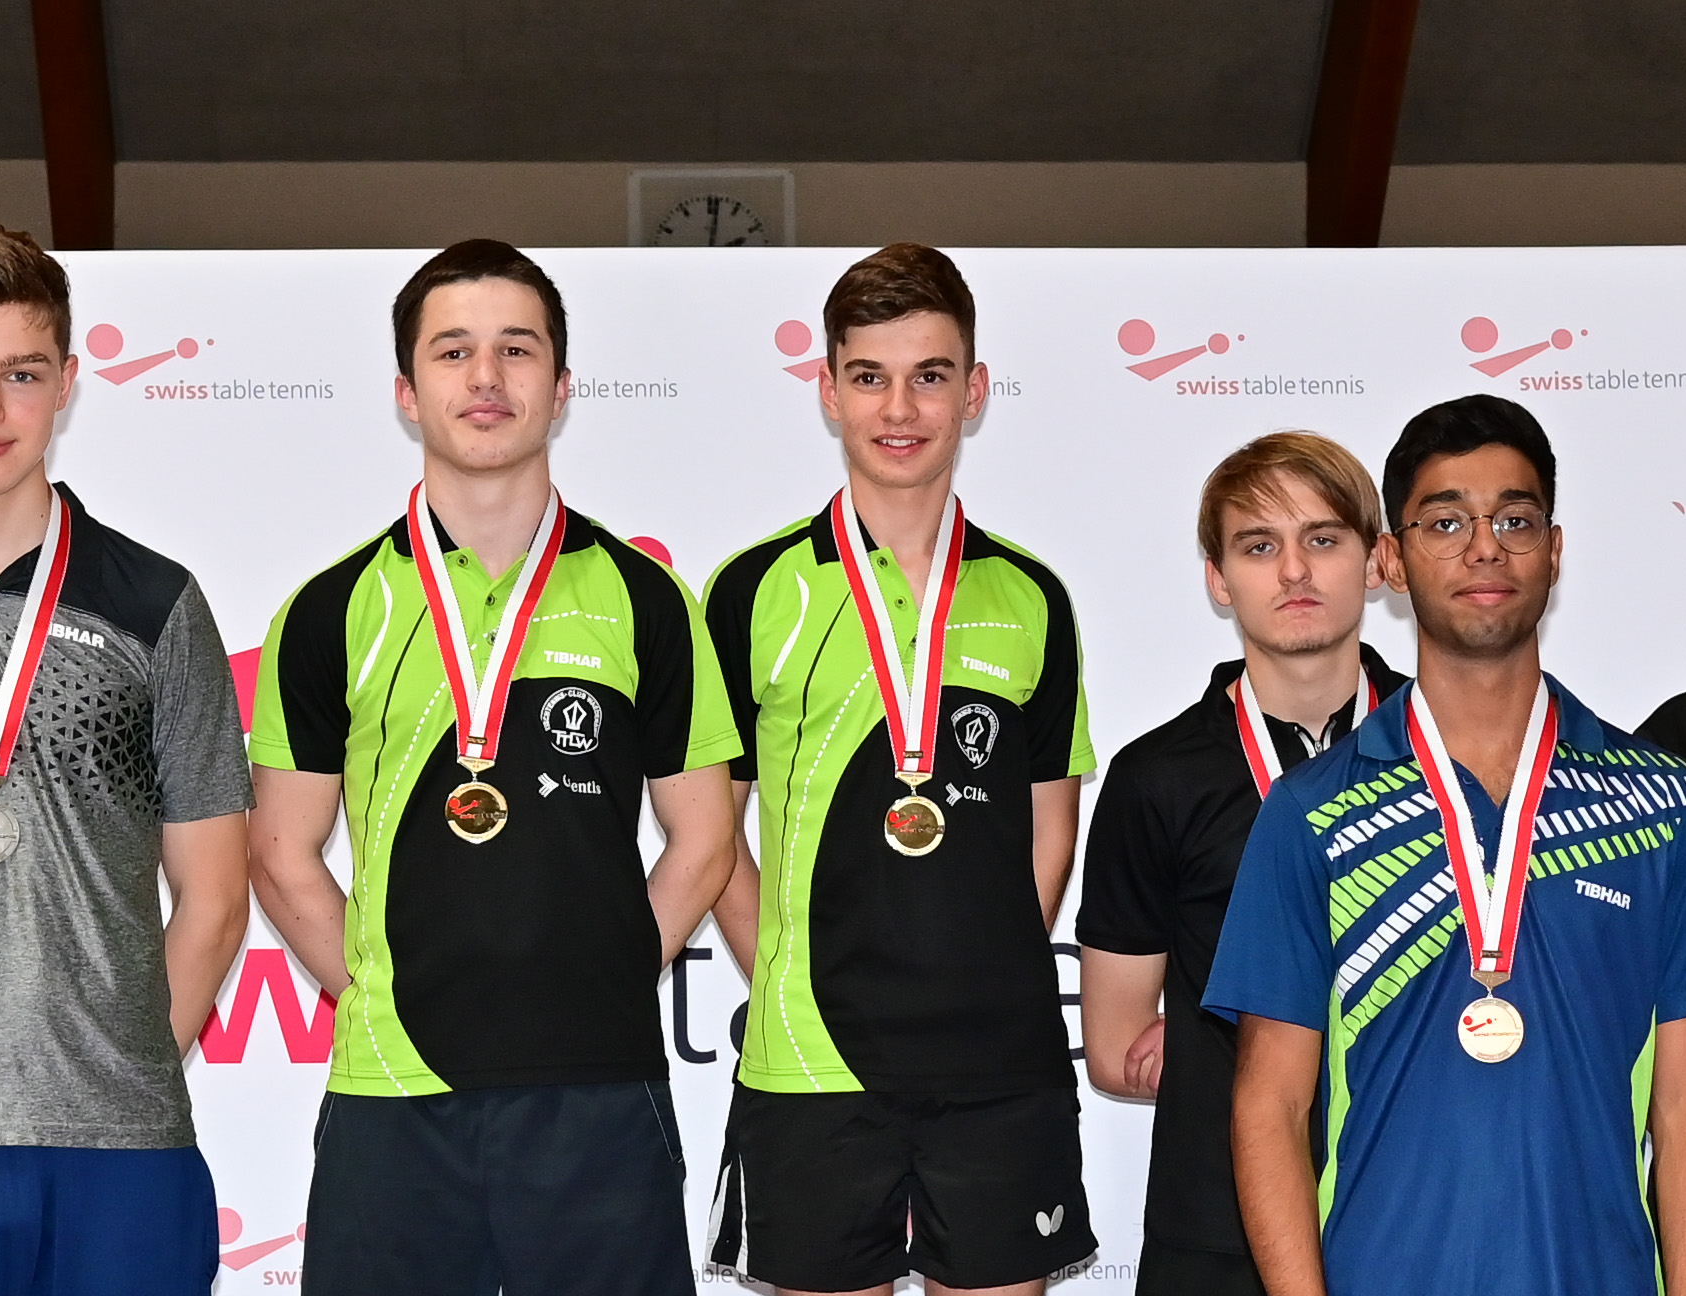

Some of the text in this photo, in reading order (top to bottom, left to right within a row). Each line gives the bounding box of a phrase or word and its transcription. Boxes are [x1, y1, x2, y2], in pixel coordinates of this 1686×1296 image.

[544, 650, 602, 669] TIBHAR
[961, 656, 1010, 681] TIBHAR
[1575, 878, 1631, 910] TIBHAR
